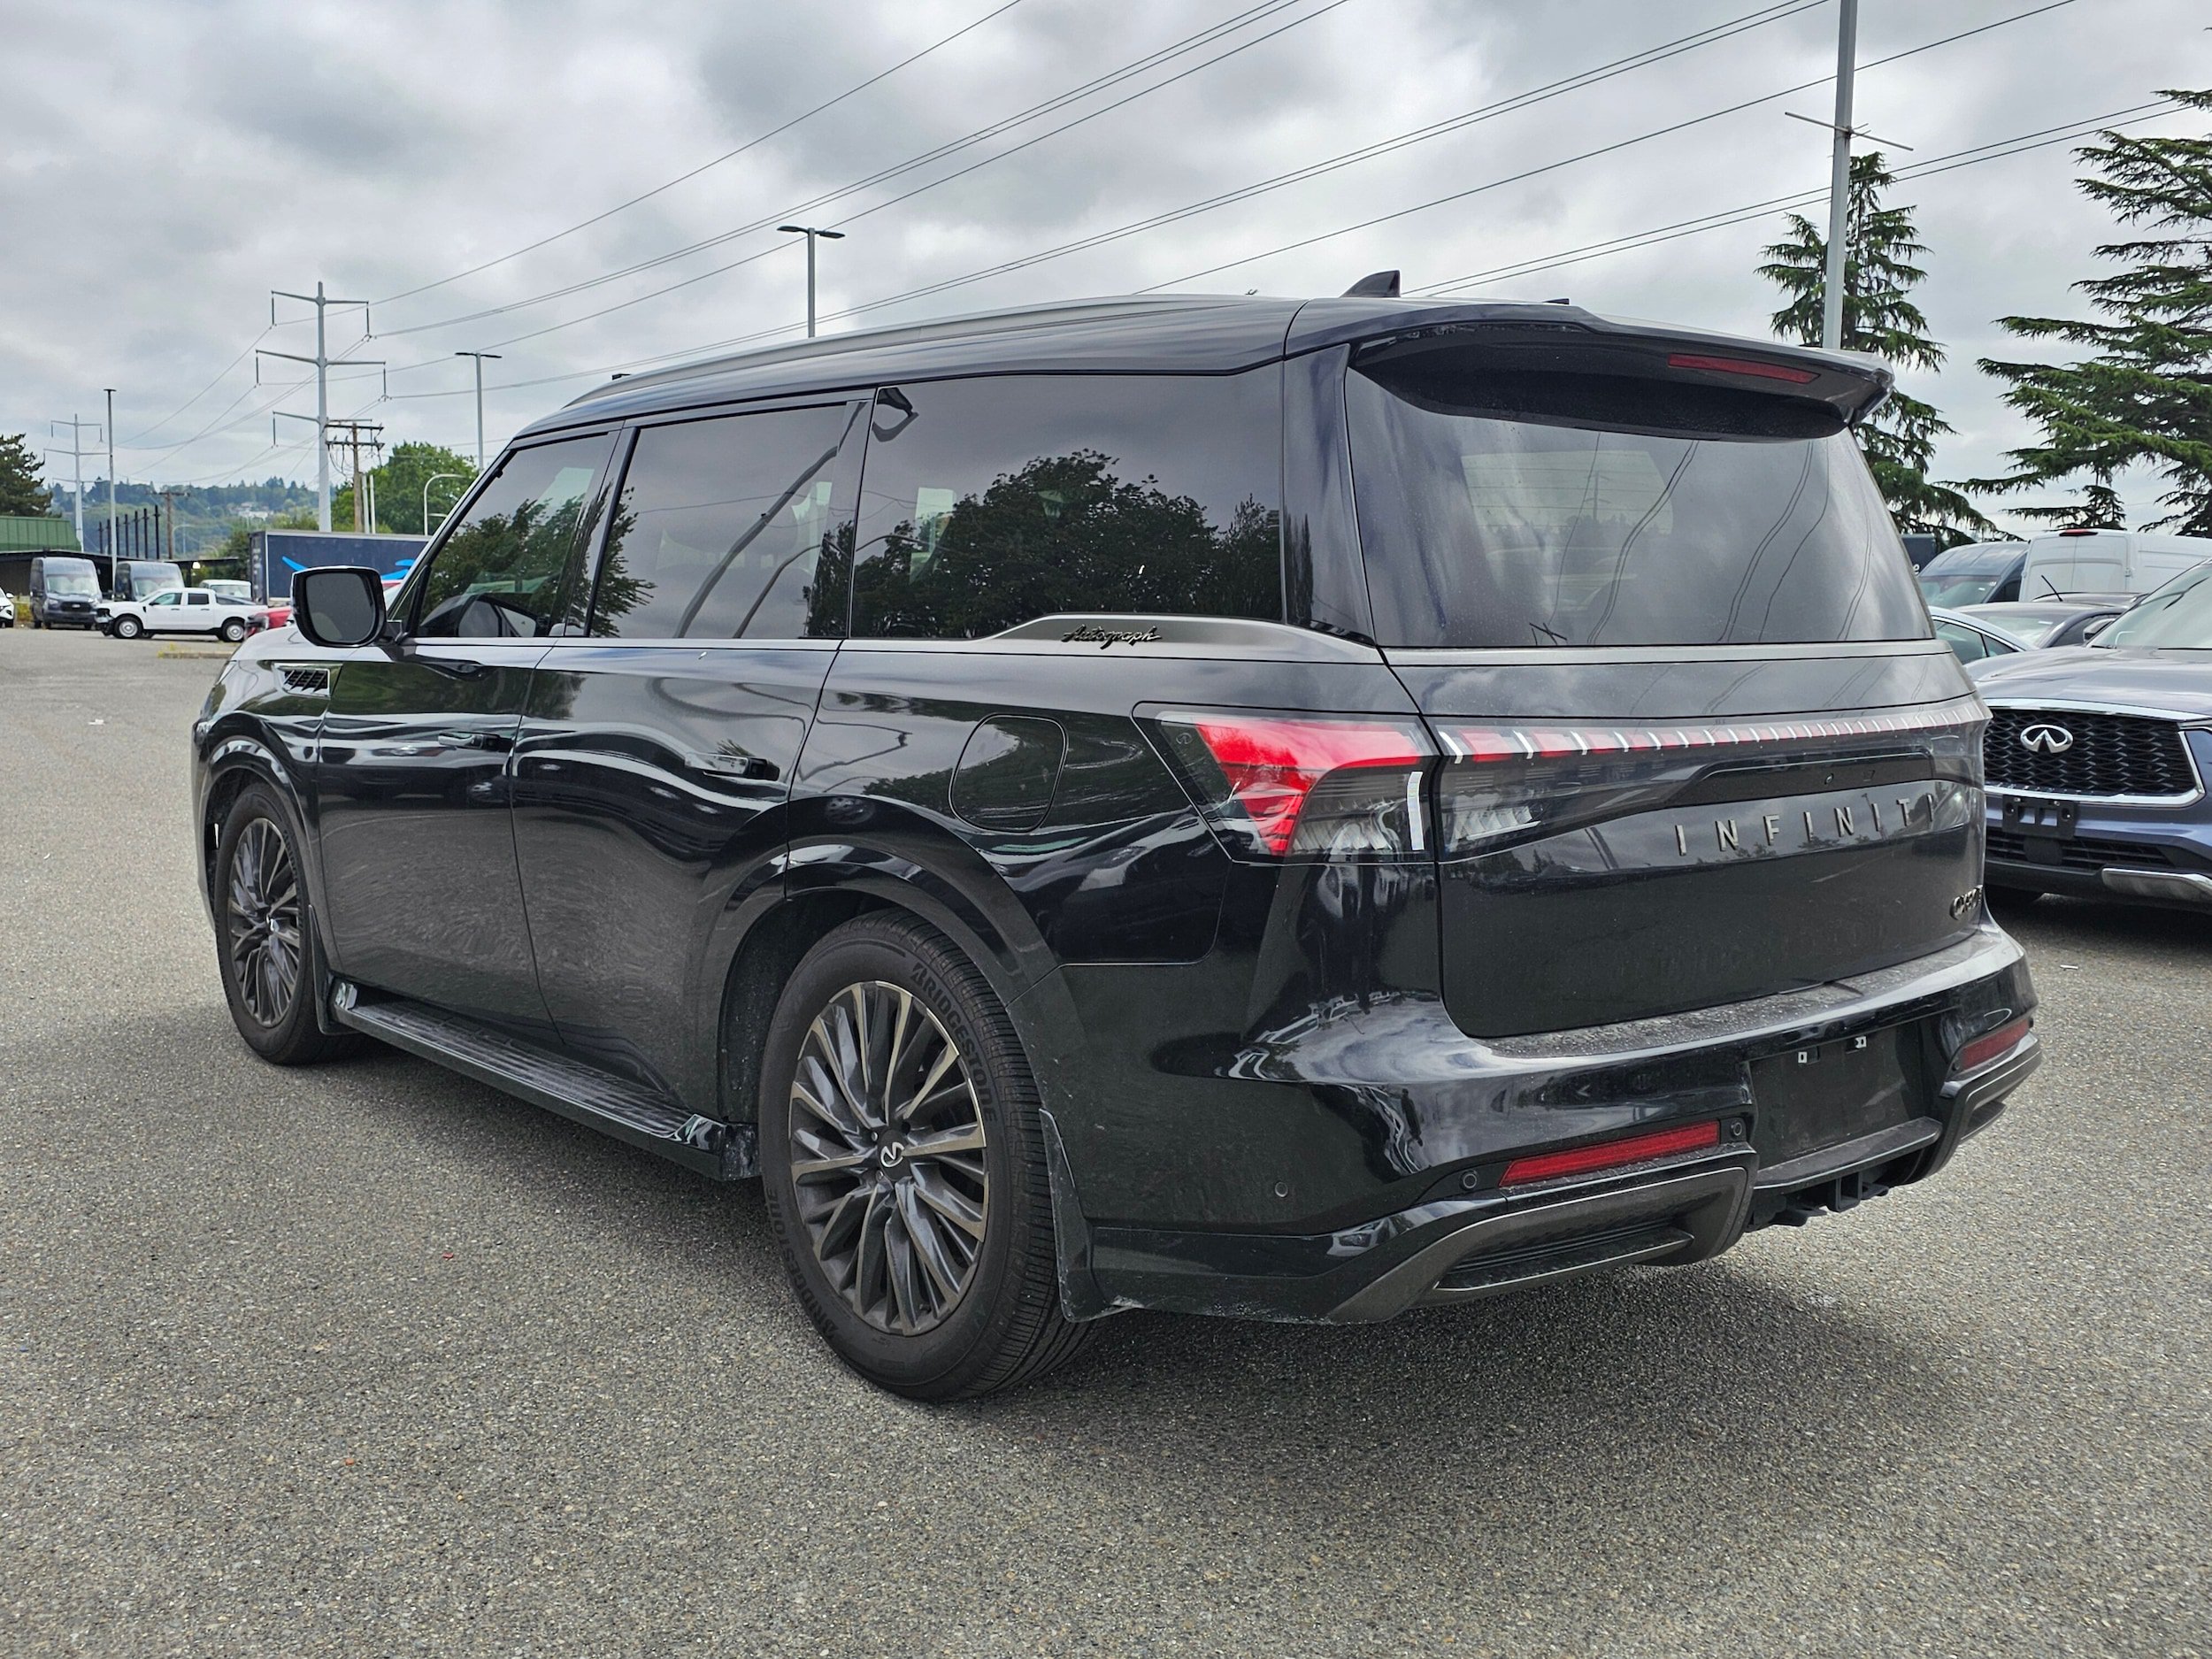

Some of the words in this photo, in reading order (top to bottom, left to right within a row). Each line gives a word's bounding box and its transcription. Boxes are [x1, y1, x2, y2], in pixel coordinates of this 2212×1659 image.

[1062, 624, 1162, 649] Autograph
[1675, 794, 1935, 856] INFINITI
[910, 962, 998, 1122] BRIDGESTONE
